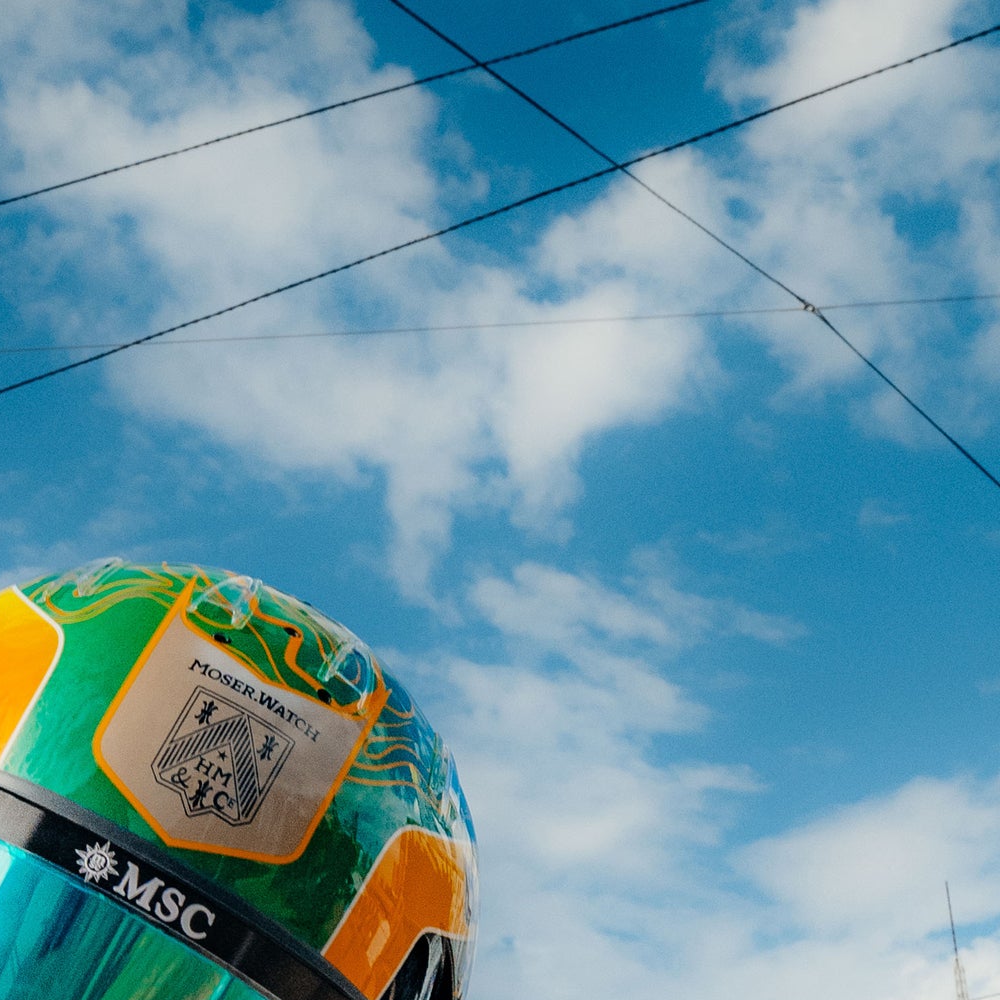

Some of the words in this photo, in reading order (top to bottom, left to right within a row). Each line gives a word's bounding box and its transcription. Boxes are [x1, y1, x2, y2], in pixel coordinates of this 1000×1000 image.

[188, 658, 321, 742] MOSER.WATCH
[193, 757, 232, 788] HM
[112, 860, 216, 940] MSC
